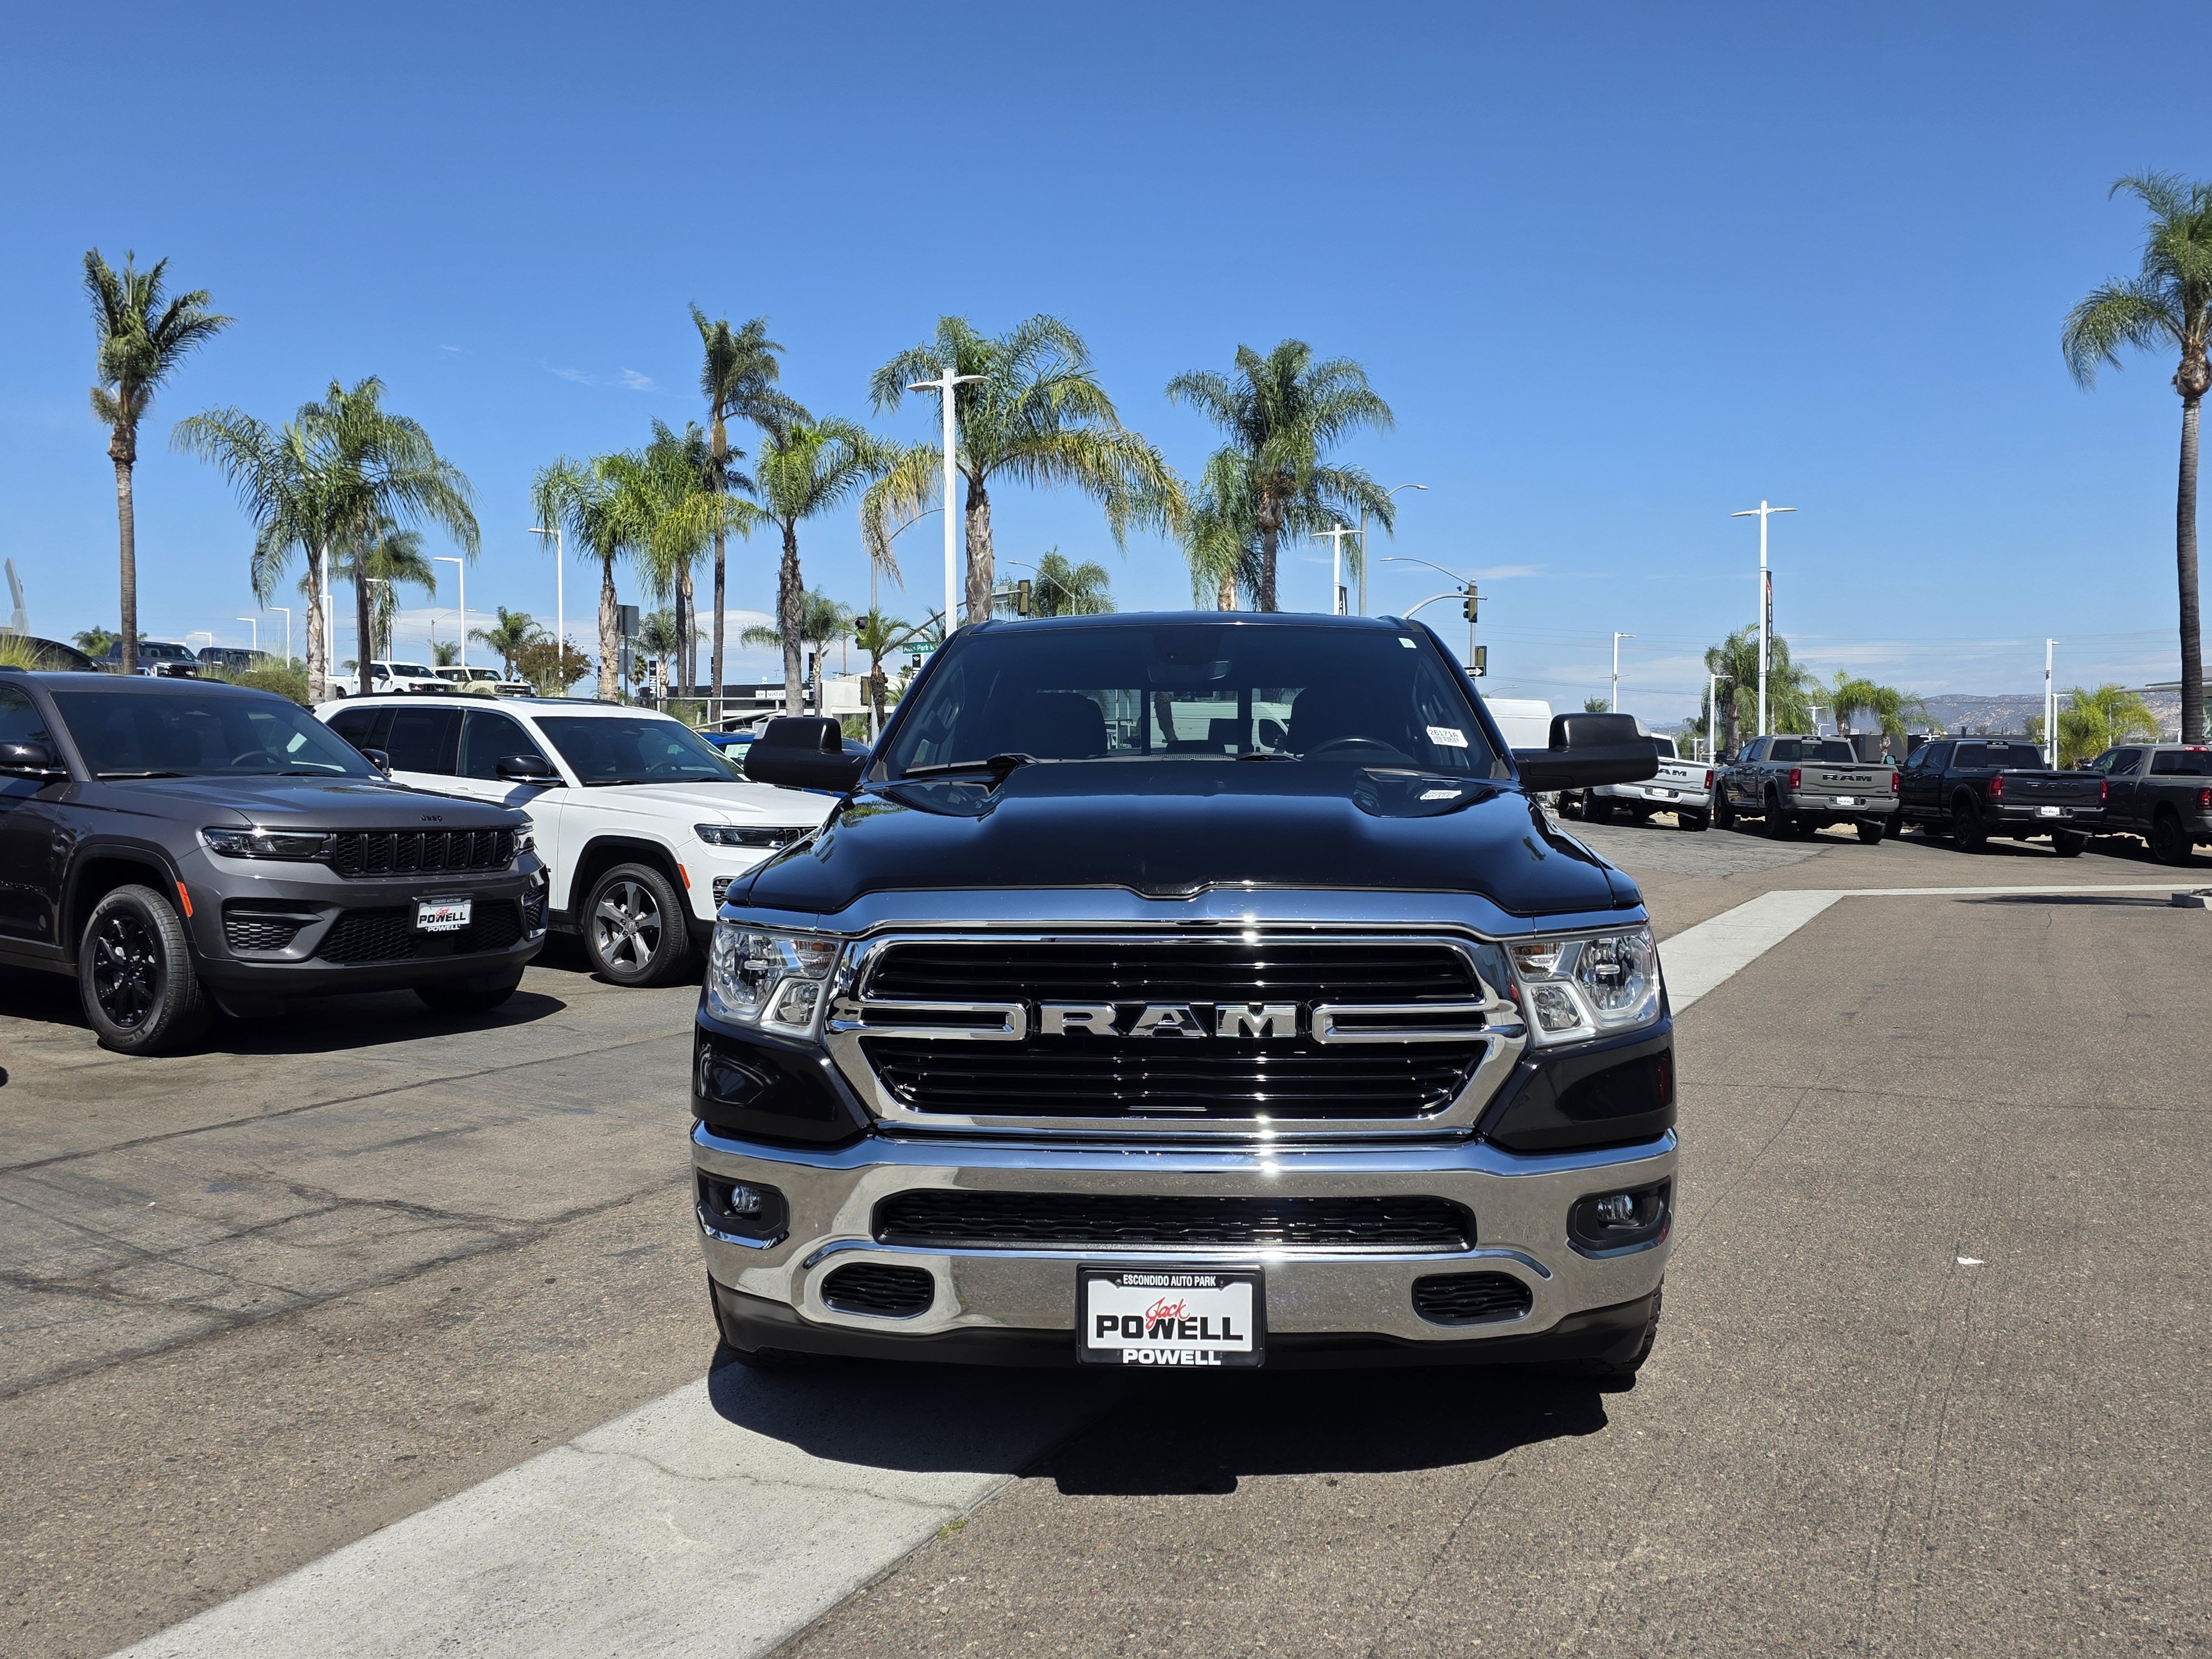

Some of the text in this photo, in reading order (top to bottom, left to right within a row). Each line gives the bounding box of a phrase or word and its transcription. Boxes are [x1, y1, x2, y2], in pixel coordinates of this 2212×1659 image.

[1658, 768, 1687, 777] AM
[1822, 773, 1872, 782] RAM
[419, 911, 466, 924] POWELL
[427, 924, 461, 932] POWELL
[1041, 1005, 1297, 1037] RAM
[1123, 1274, 1216, 1287] ESCONDIDO AUTO PARK
[1145, 1296, 1190, 1330] Jack
[1096, 1314, 1244, 1342] POWELL
[1122, 1349, 1222, 1365] POWELL
